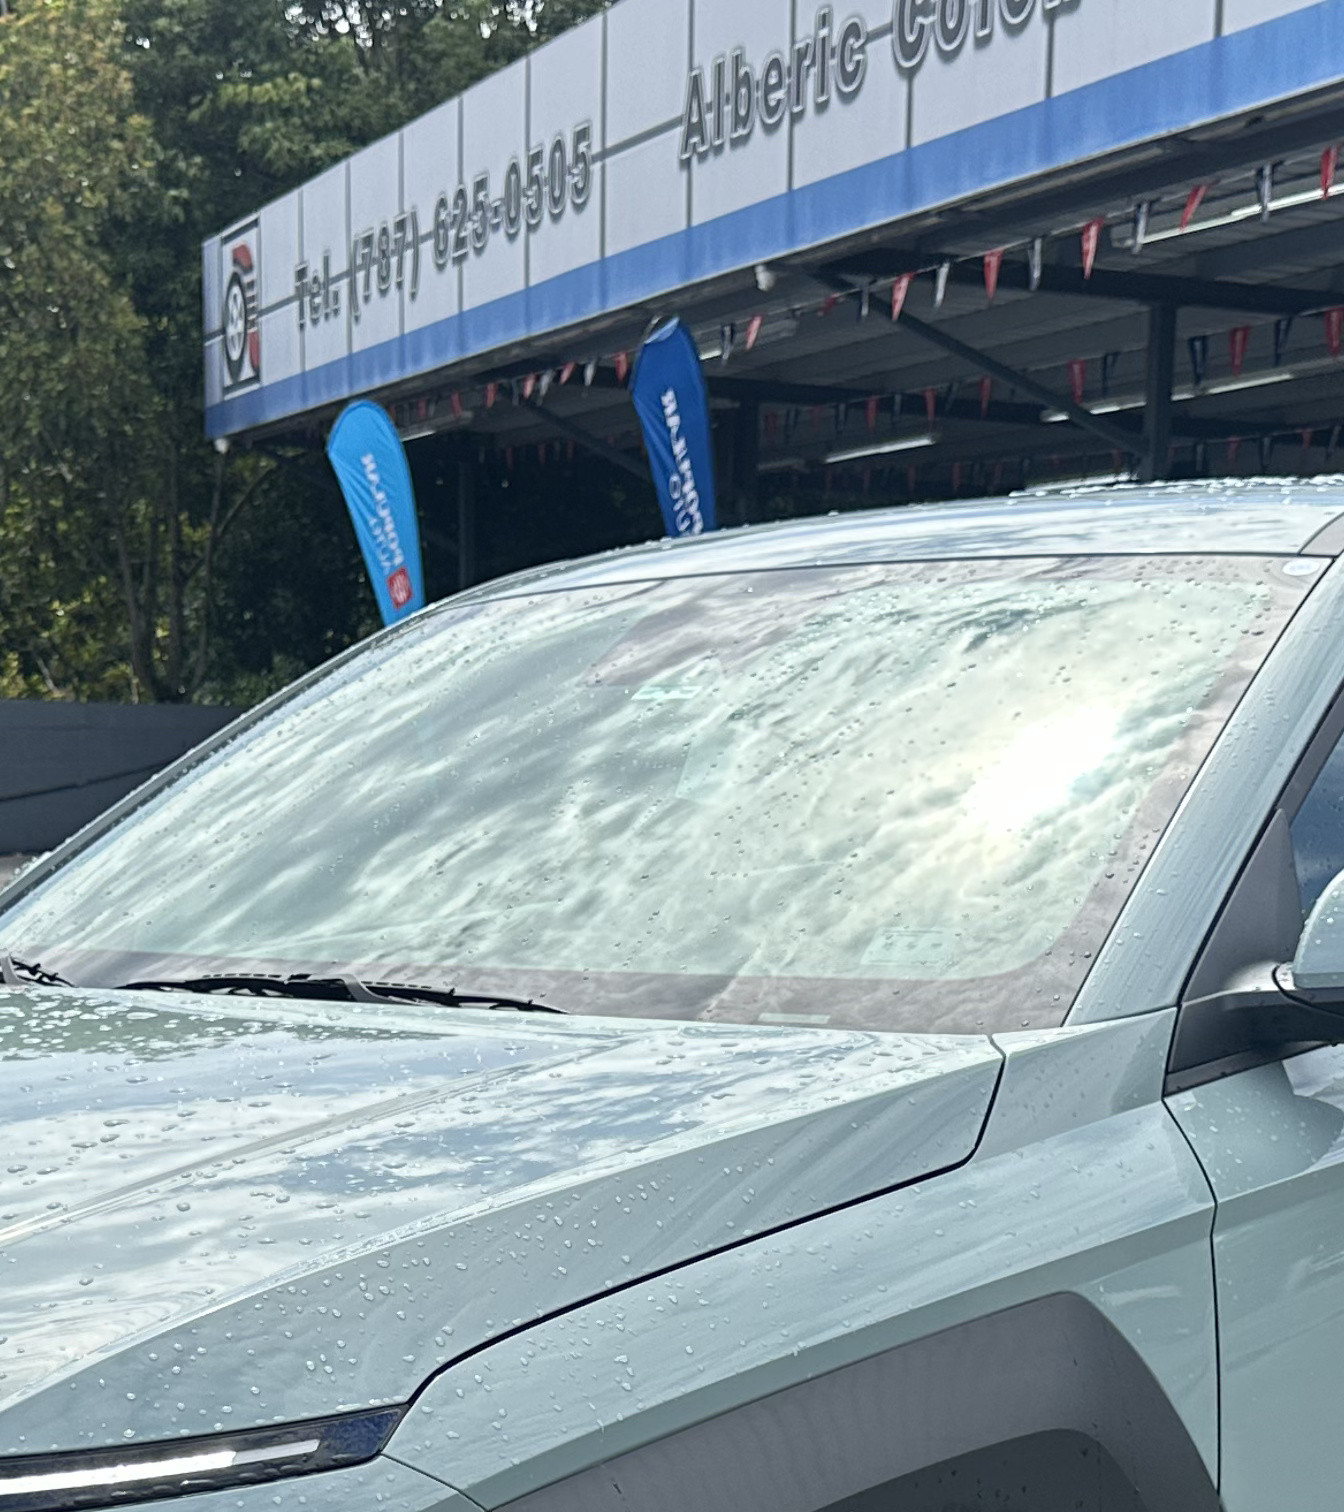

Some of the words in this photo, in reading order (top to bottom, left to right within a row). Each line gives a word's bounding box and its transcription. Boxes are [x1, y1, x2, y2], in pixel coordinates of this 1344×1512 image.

[679, 6, 867, 160] Alberic
[294, 252, 340, 329] Tel.
[350, 206, 419, 322] (787)
[433, 119, 593, 271] 625-0505
